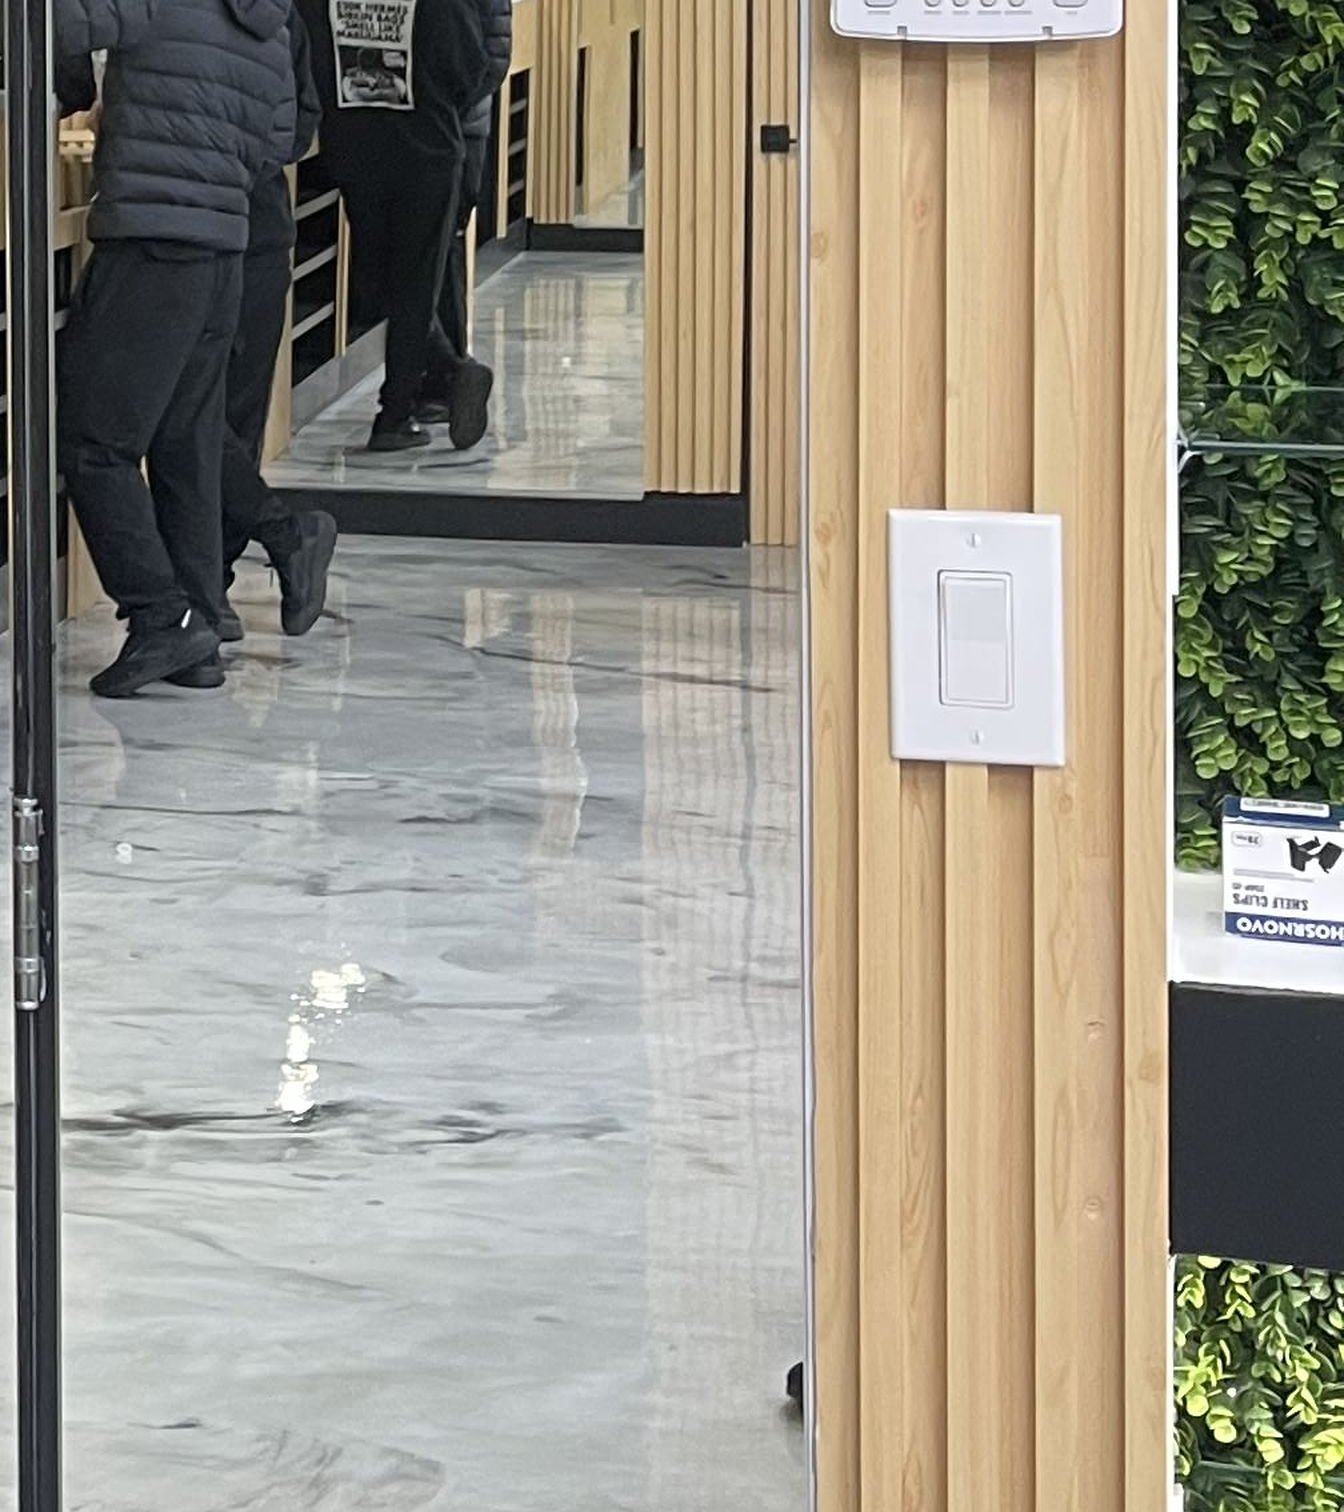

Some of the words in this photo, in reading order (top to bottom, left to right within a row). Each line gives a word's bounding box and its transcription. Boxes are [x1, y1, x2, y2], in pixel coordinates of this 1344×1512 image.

[1232, 892, 1269, 908] CLIPS
[1272, 895, 1309, 911] SHELF
[1236, 917, 1344, 940] HOSRNOVO
